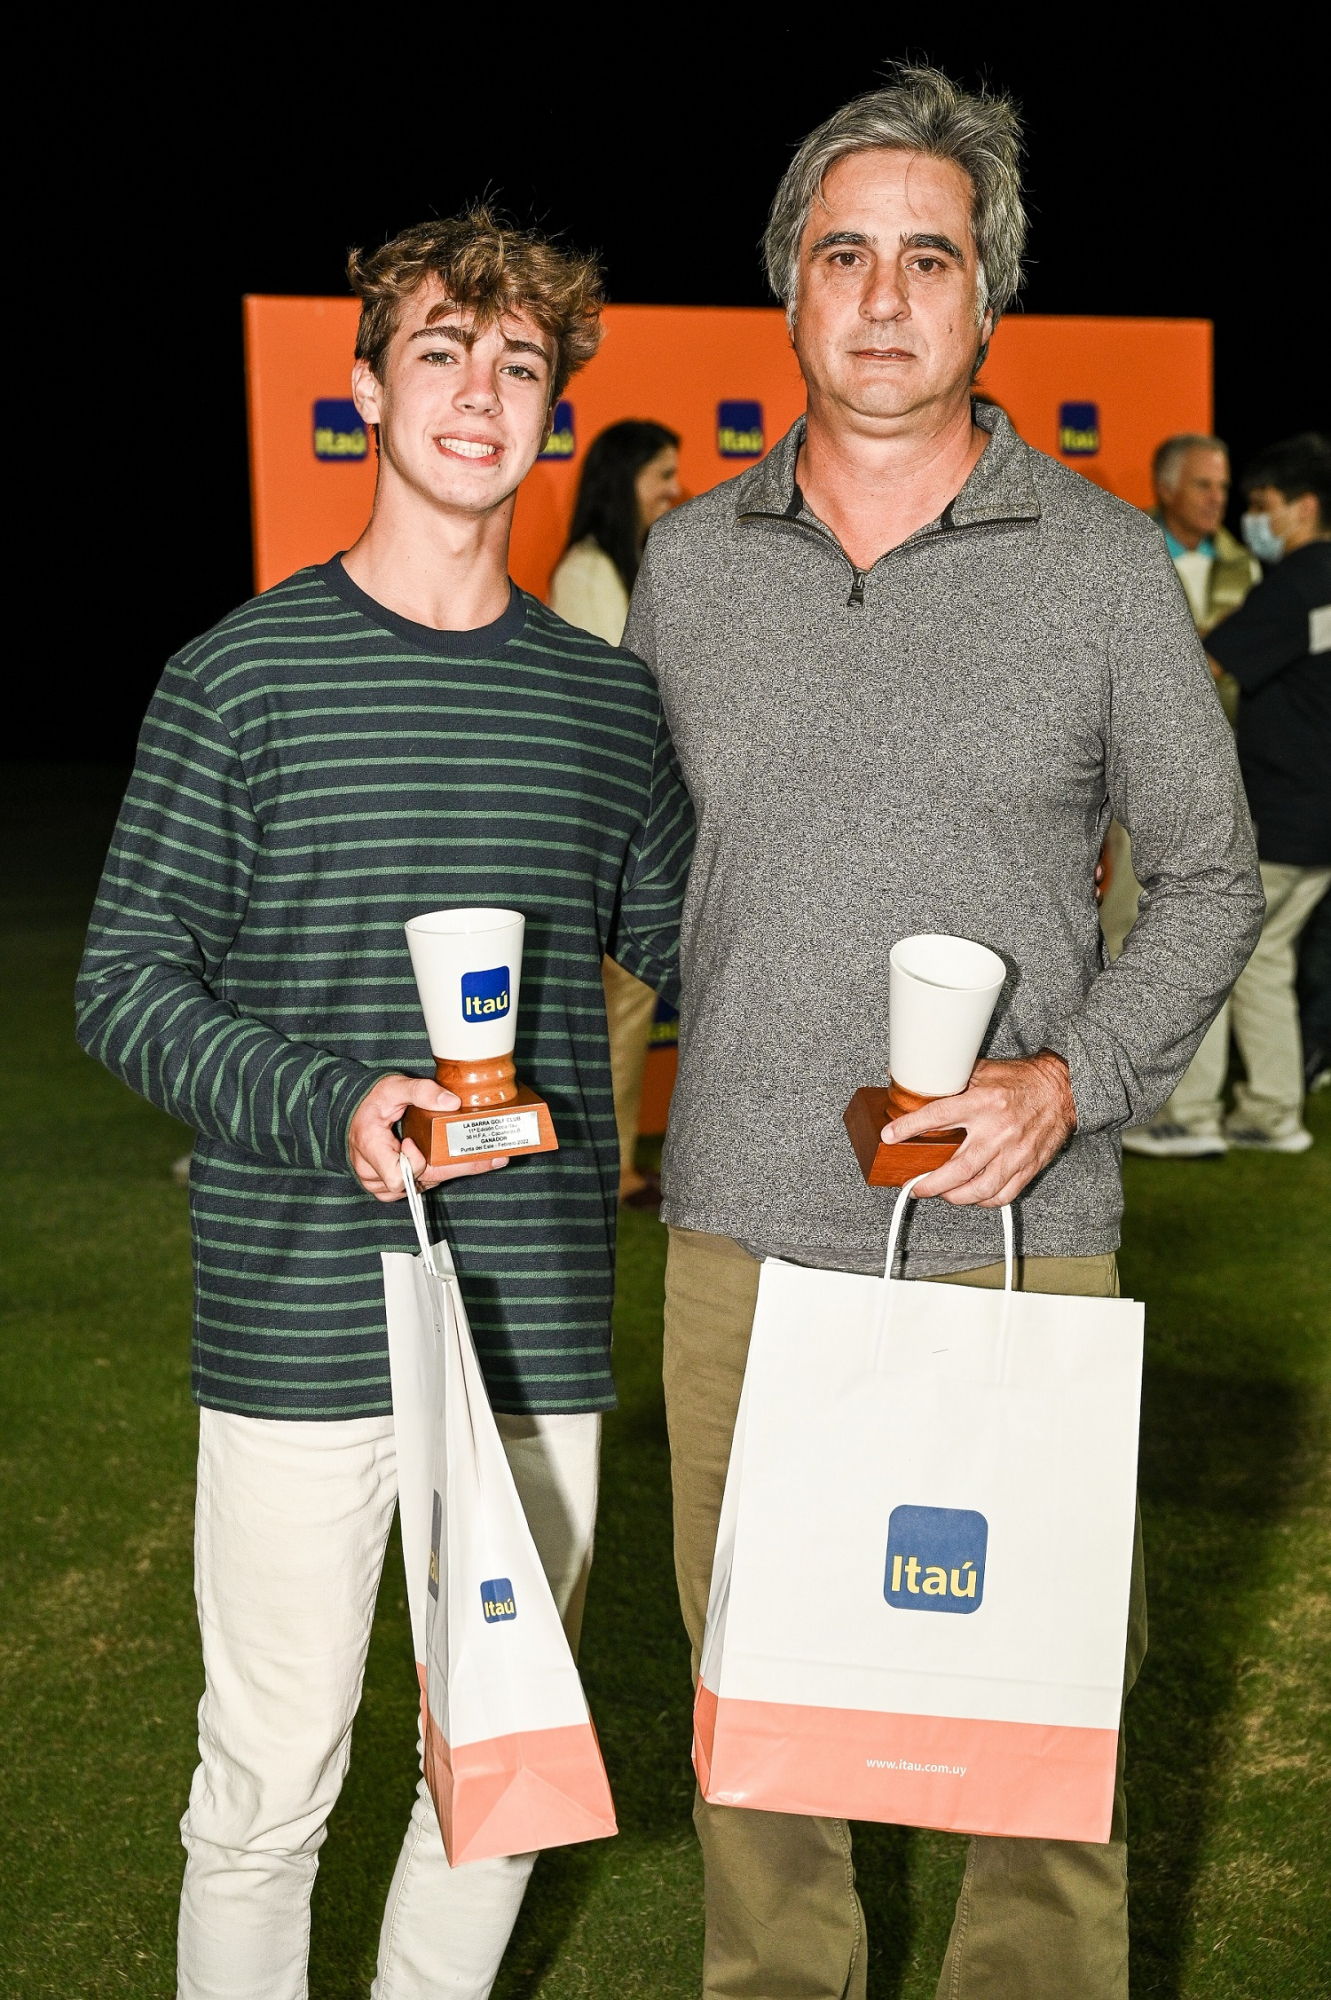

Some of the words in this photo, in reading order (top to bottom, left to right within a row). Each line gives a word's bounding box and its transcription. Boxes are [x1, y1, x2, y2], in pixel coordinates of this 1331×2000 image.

[545, 427, 575, 454] aú
[465, 990, 508, 1015] Itaú
[480, 1136, 508, 1144] GANADOR
[891, 1555, 977, 1598] Itaú
[484, 1598, 515, 1618] Itaú
[866, 1759, 966, 1777] www.itau.com.uy
